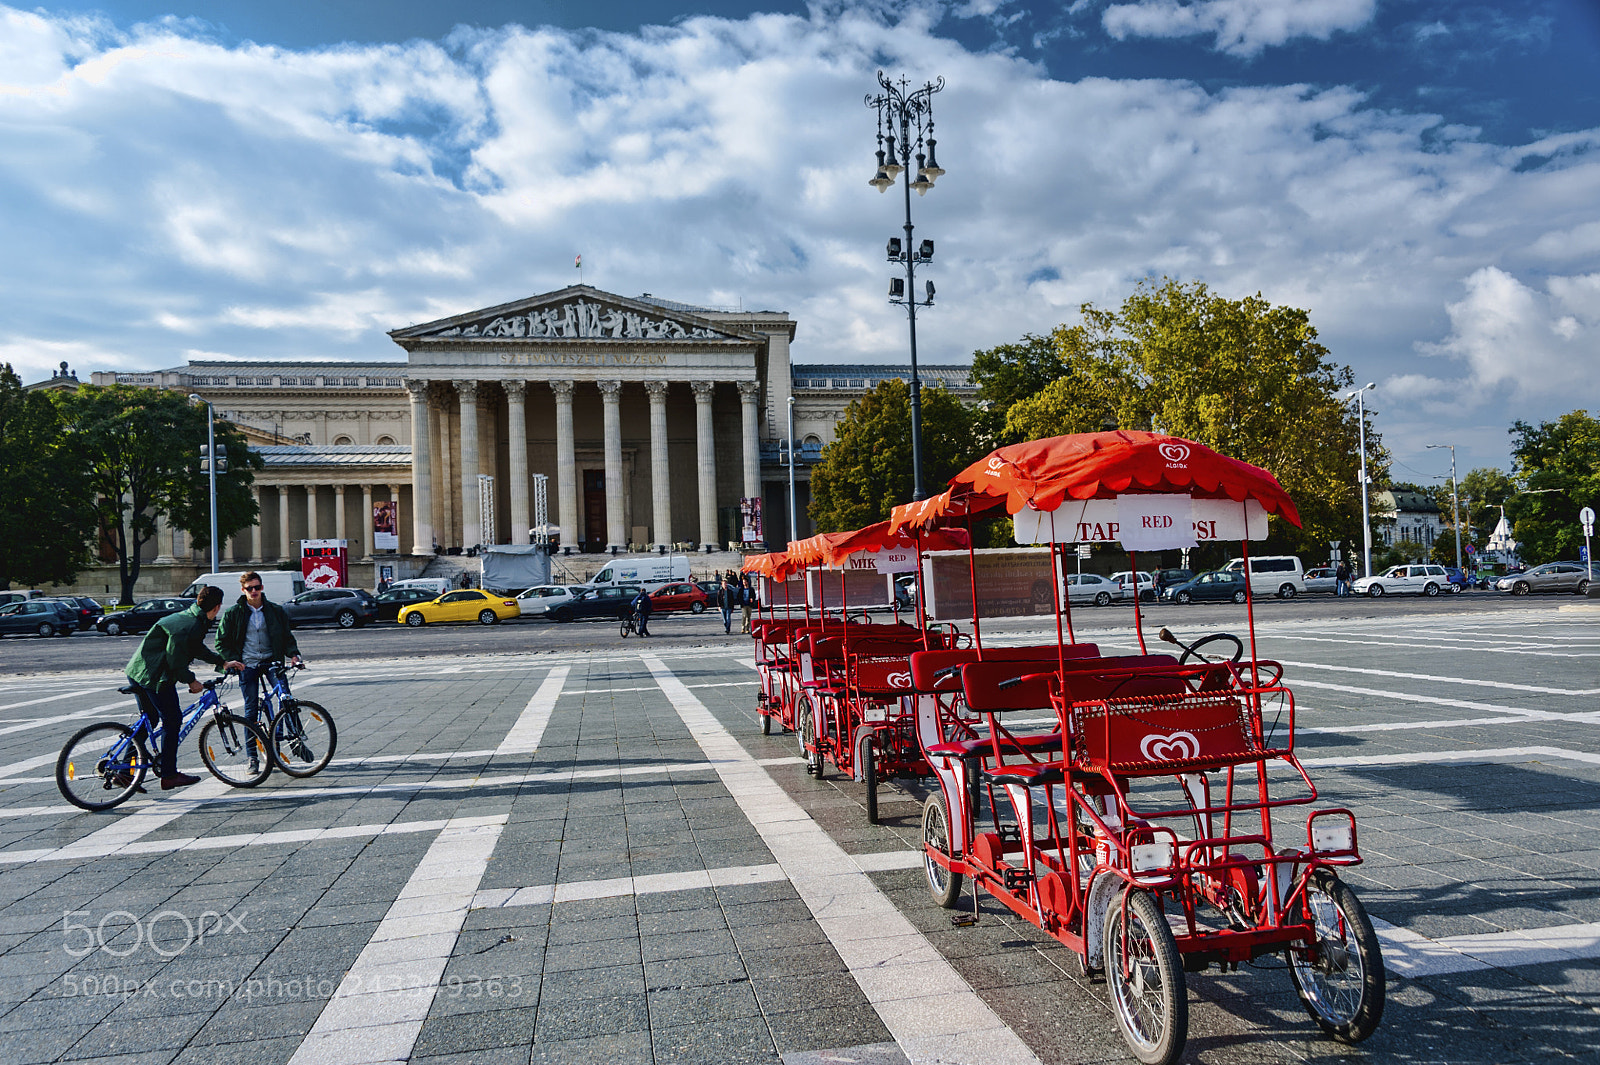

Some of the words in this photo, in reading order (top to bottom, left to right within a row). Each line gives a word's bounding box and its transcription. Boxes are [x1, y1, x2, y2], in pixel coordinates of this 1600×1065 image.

[1141, 515, 1173, 529] RED
[1076, 521, 1120, 541] TAP
[1191, 519, 1218, 540] SI
[851, 558, 877, 569] MIK
[888, 554, 907, 562] RED
